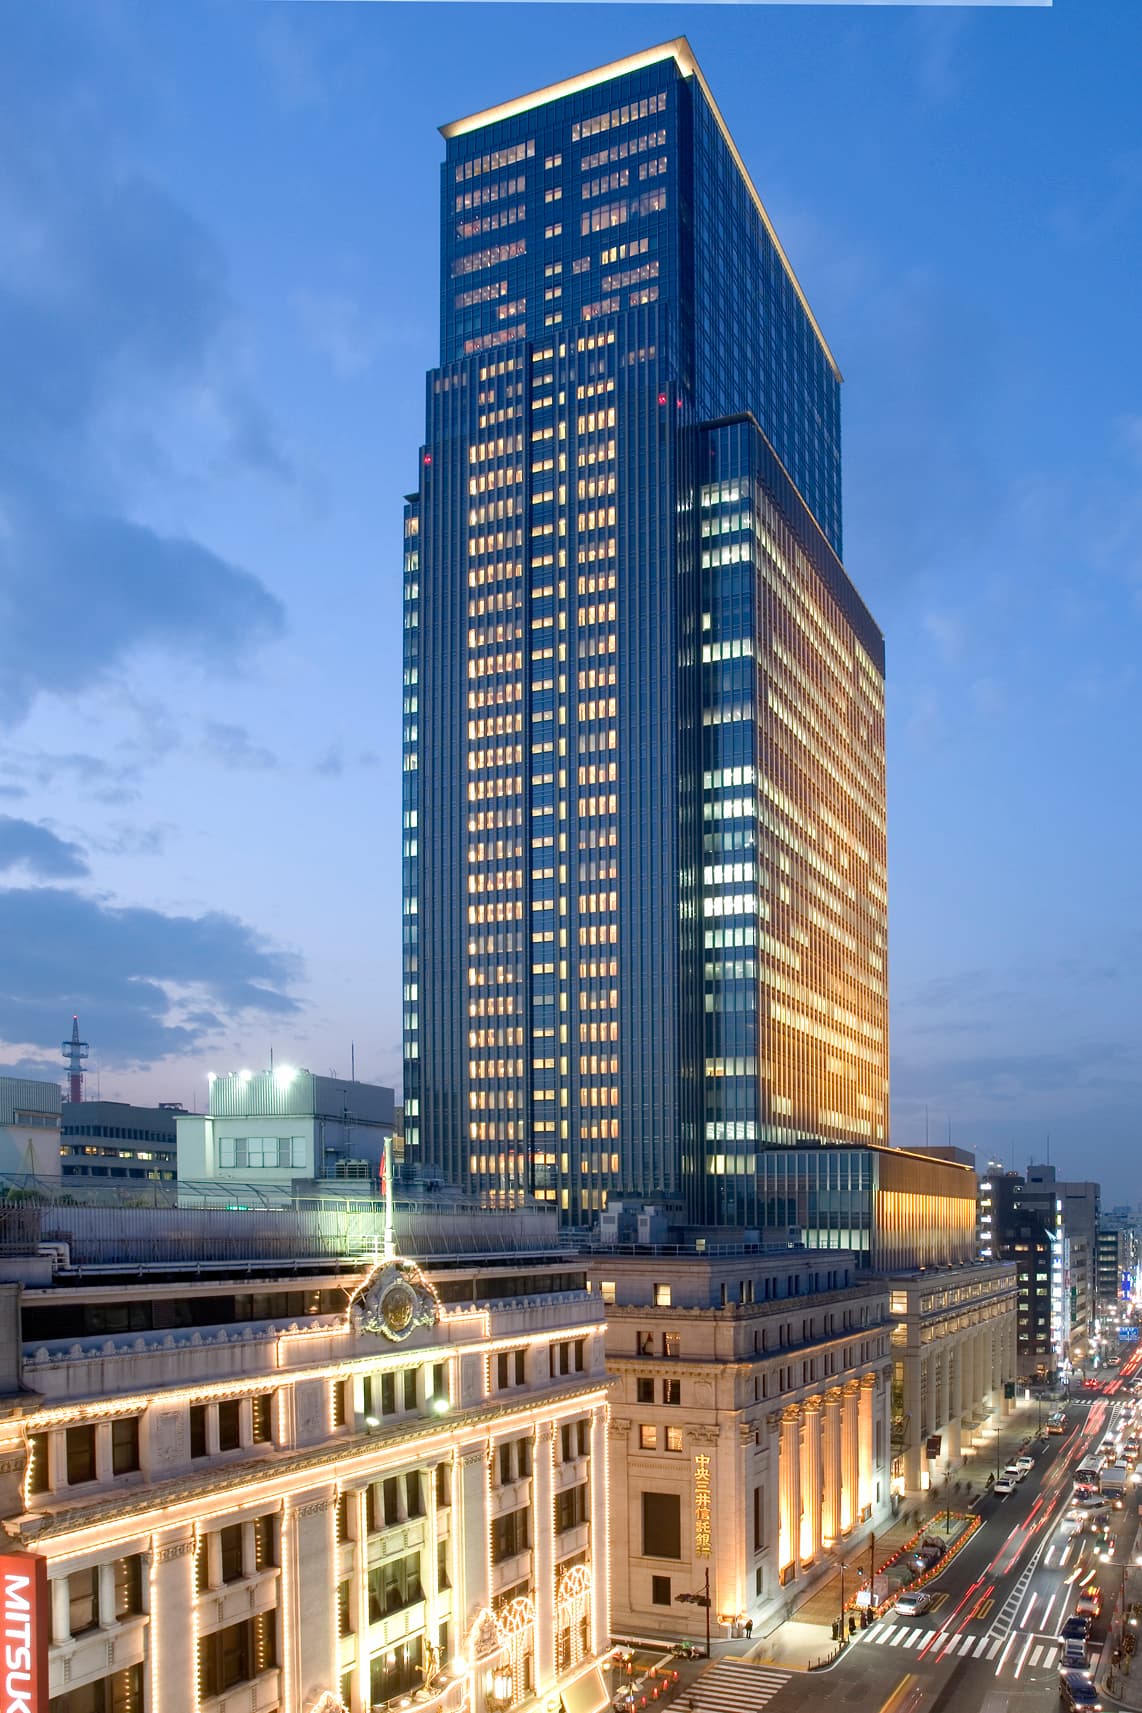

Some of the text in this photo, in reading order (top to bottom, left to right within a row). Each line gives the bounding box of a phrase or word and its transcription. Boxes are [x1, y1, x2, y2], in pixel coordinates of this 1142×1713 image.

[695, 1454, 712, 1559] 中央三井信託銀行
